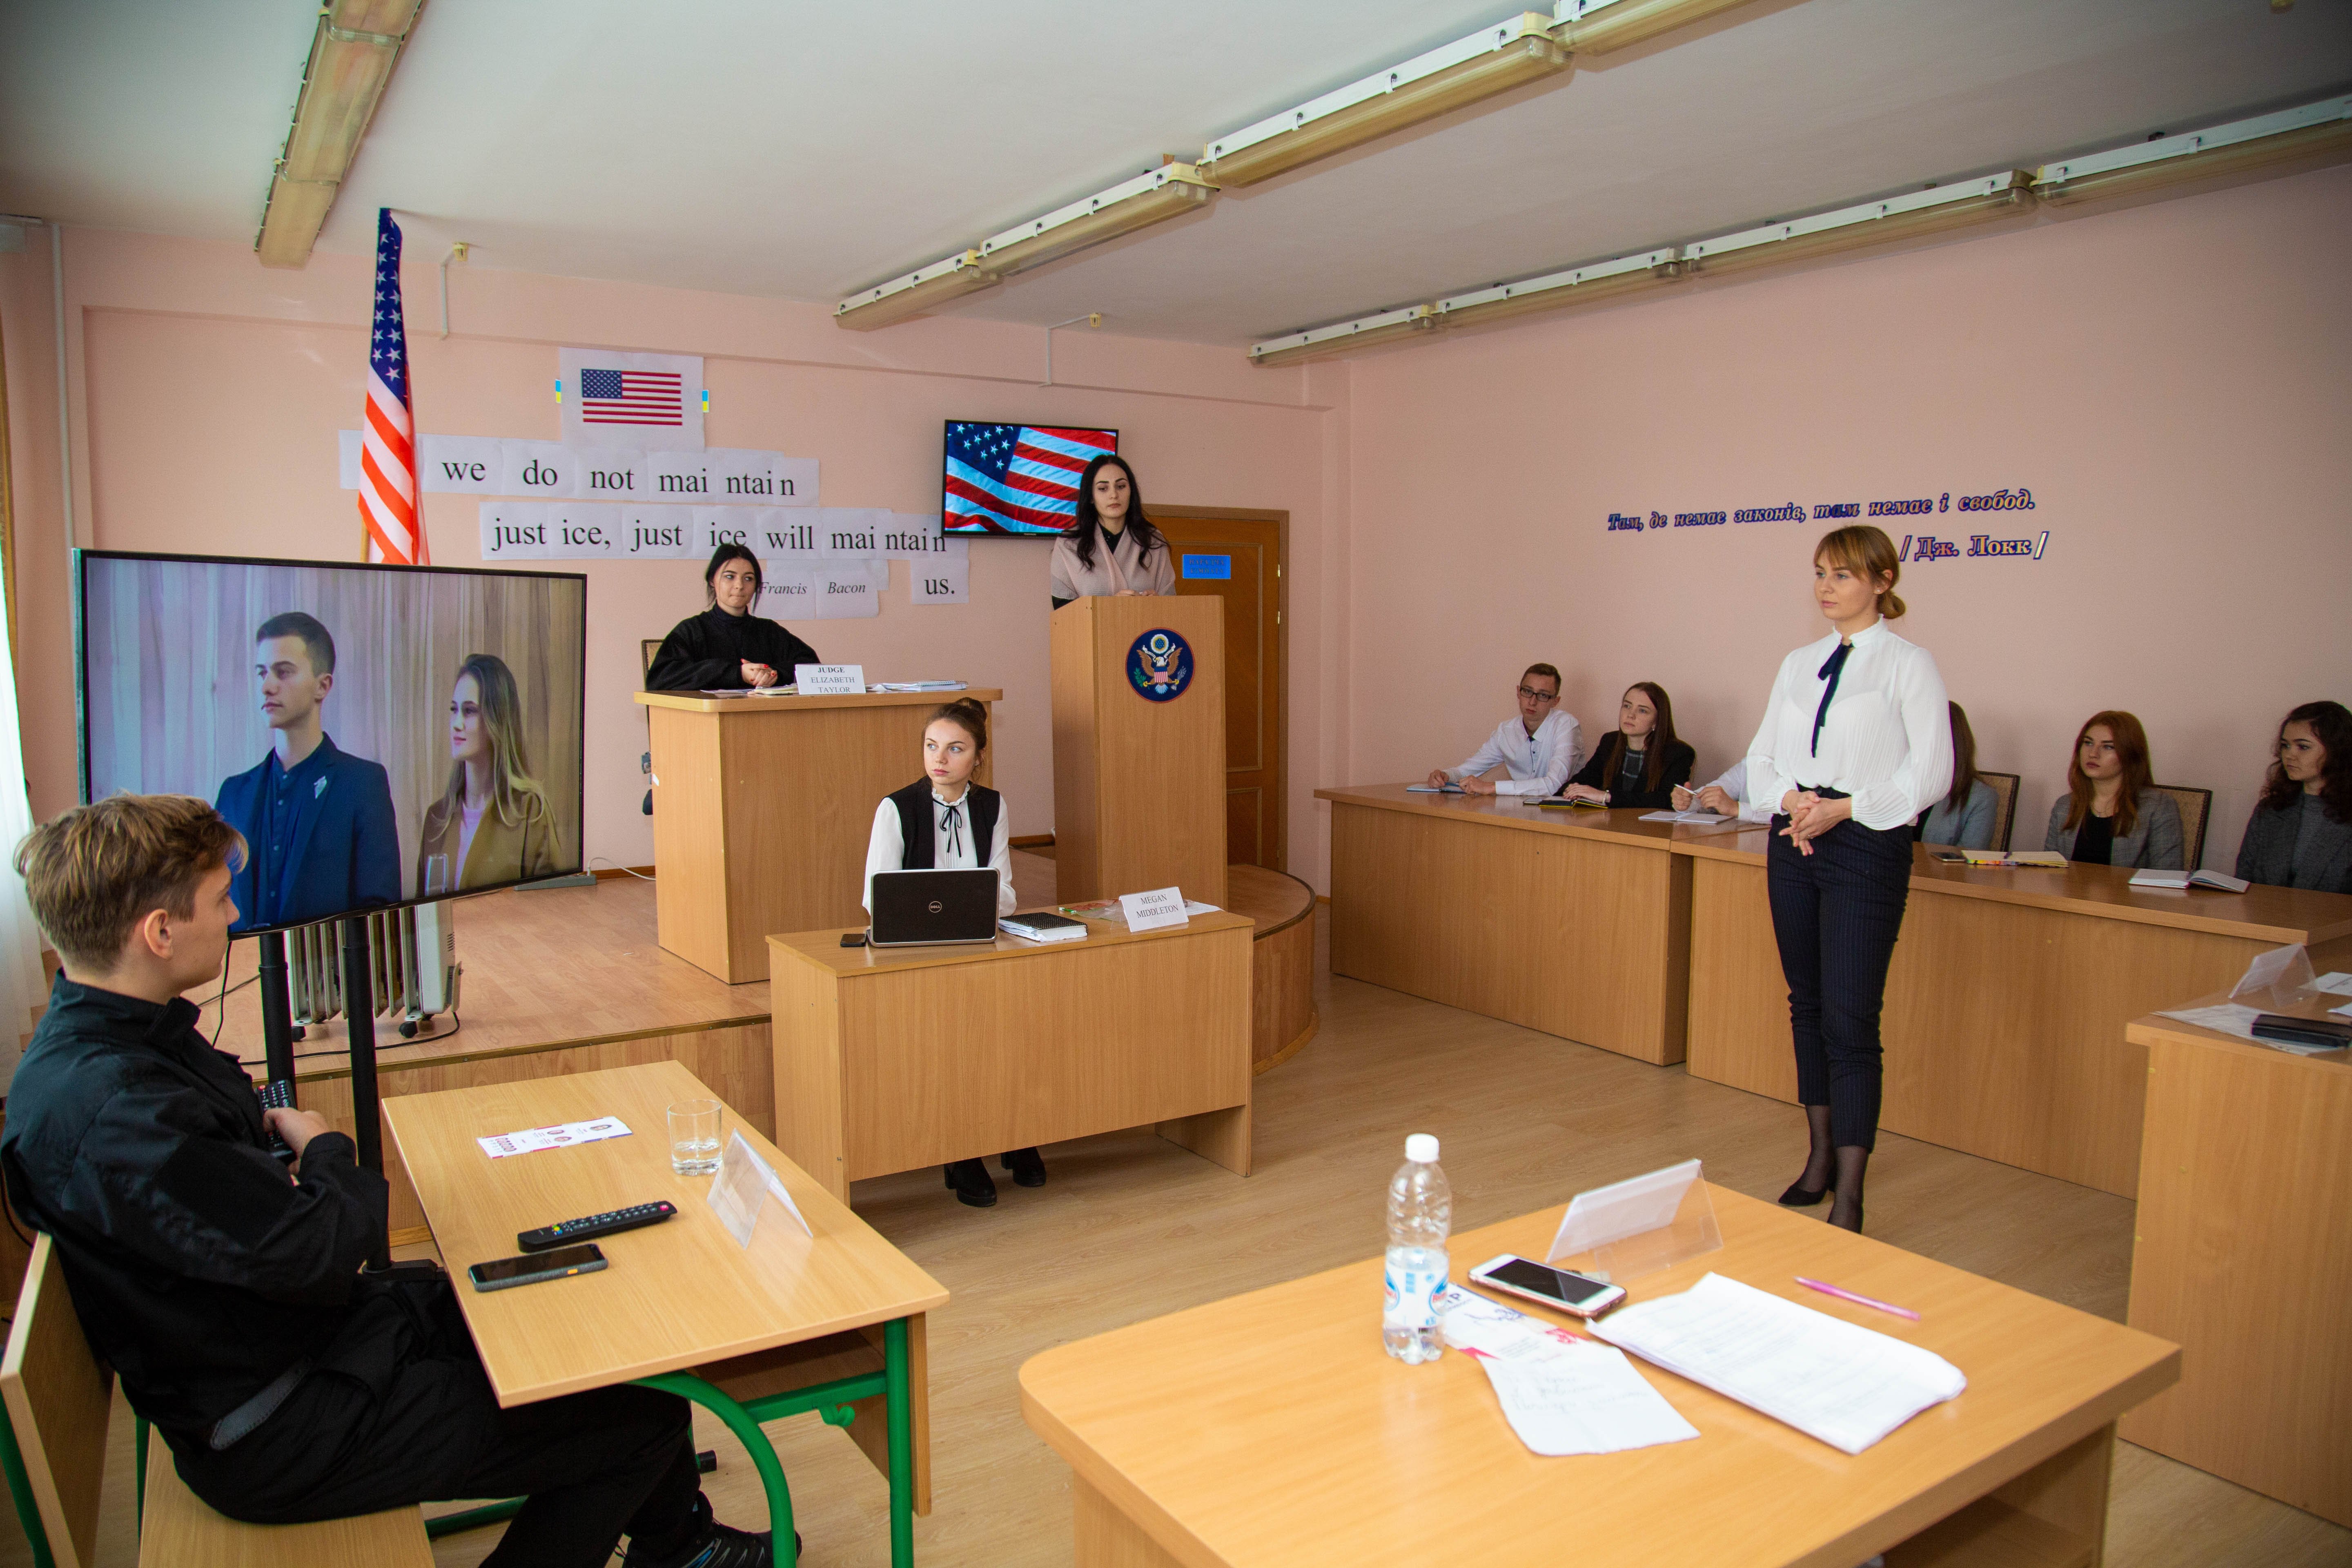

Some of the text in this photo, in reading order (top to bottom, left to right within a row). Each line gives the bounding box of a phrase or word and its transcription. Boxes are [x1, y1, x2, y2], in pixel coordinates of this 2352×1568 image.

[441, 462, 486, 482] we
[522, 459, 558, 486] do
[590, 469, 635, 490] not
[1608, 488, 2035, 532] Там, де немає законів, там немає і свобод.
[766, 525, 814, 550] will
[760, 581, 866, 594] Francis Bacon
[924, 578, 955, 595] us.
[1140, 894, 1167, 905] MEGAN
[1136, 904, 1179, 918] MIDDLETON
